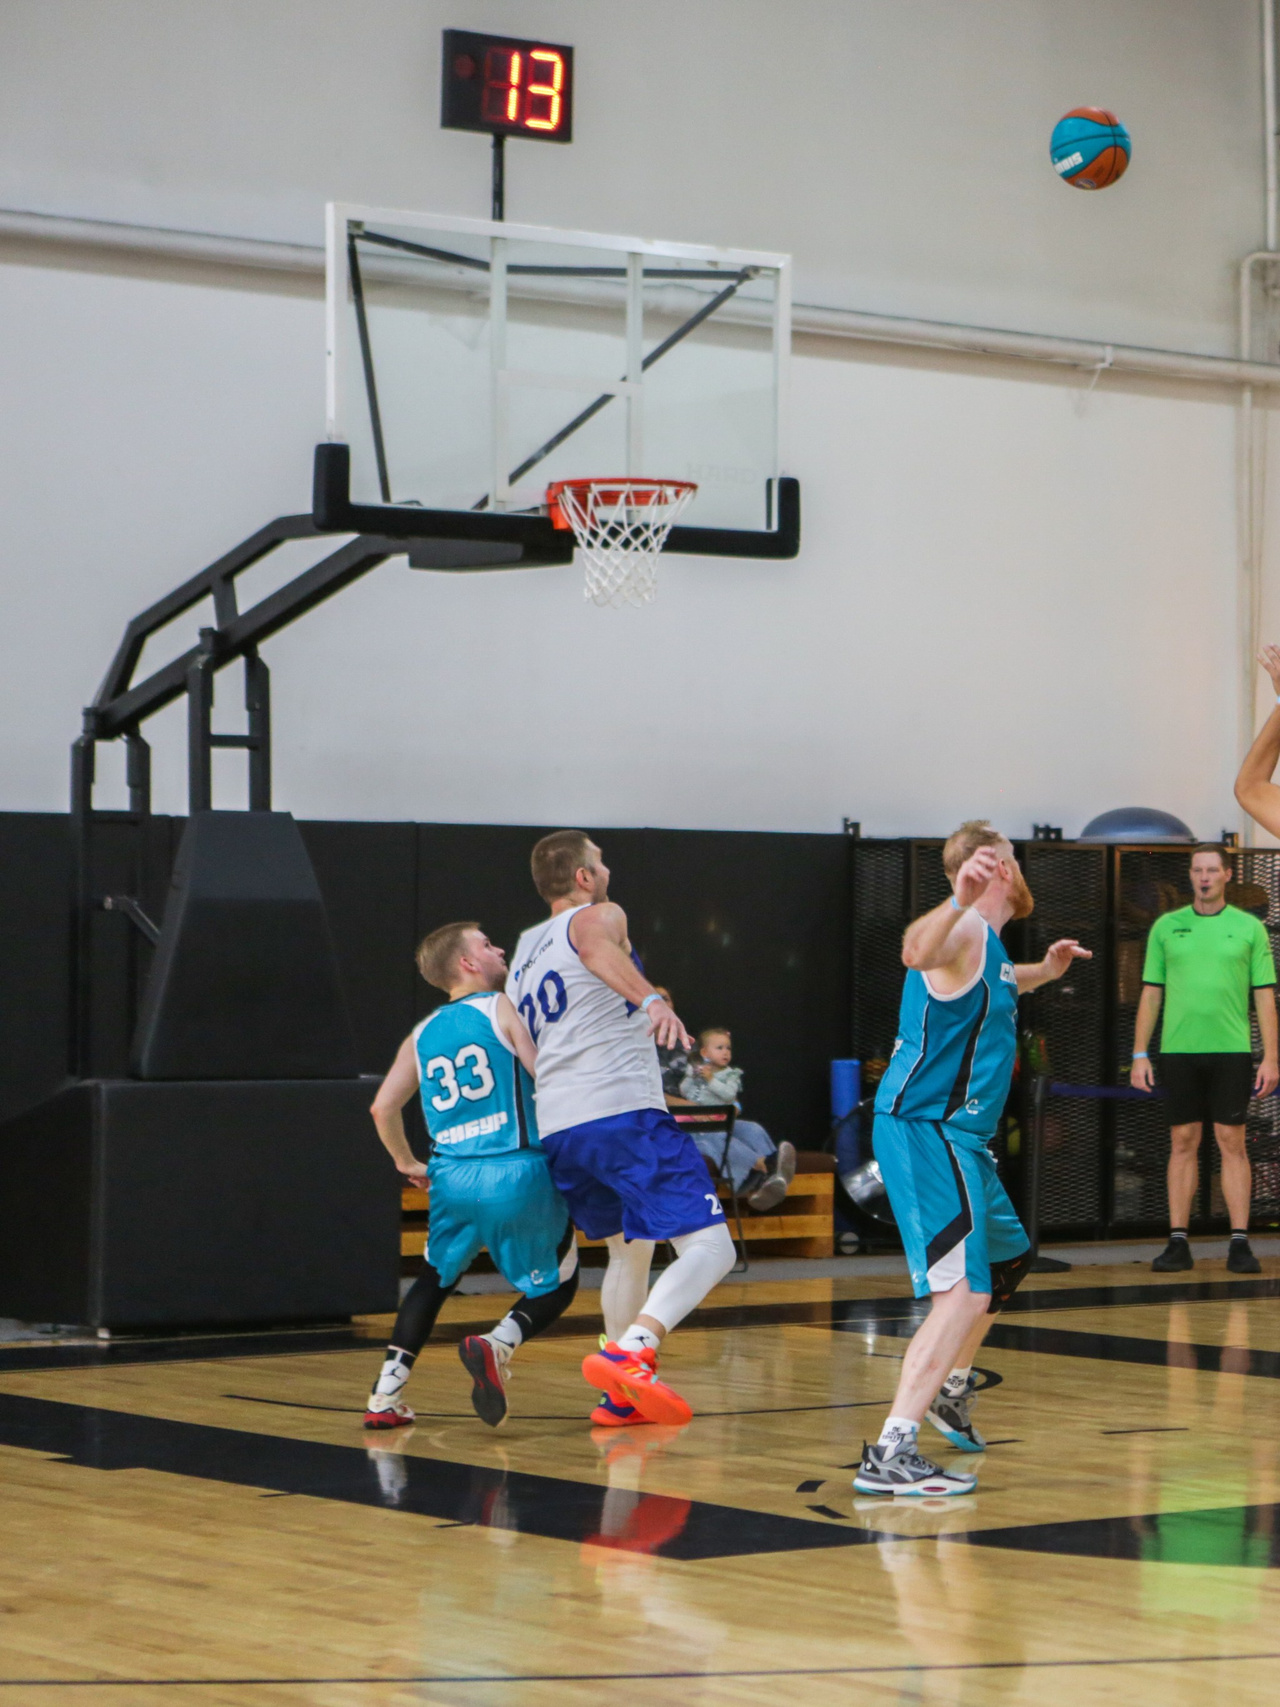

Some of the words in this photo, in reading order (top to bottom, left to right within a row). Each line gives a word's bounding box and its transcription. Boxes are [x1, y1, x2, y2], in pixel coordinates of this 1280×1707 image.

[506, 49, 563, 131] 13
[426, 1043, 496, 1112] 33
[436, 1111, 508, 1145] СИБУР
[704, 1193, 724, 1216] 2
